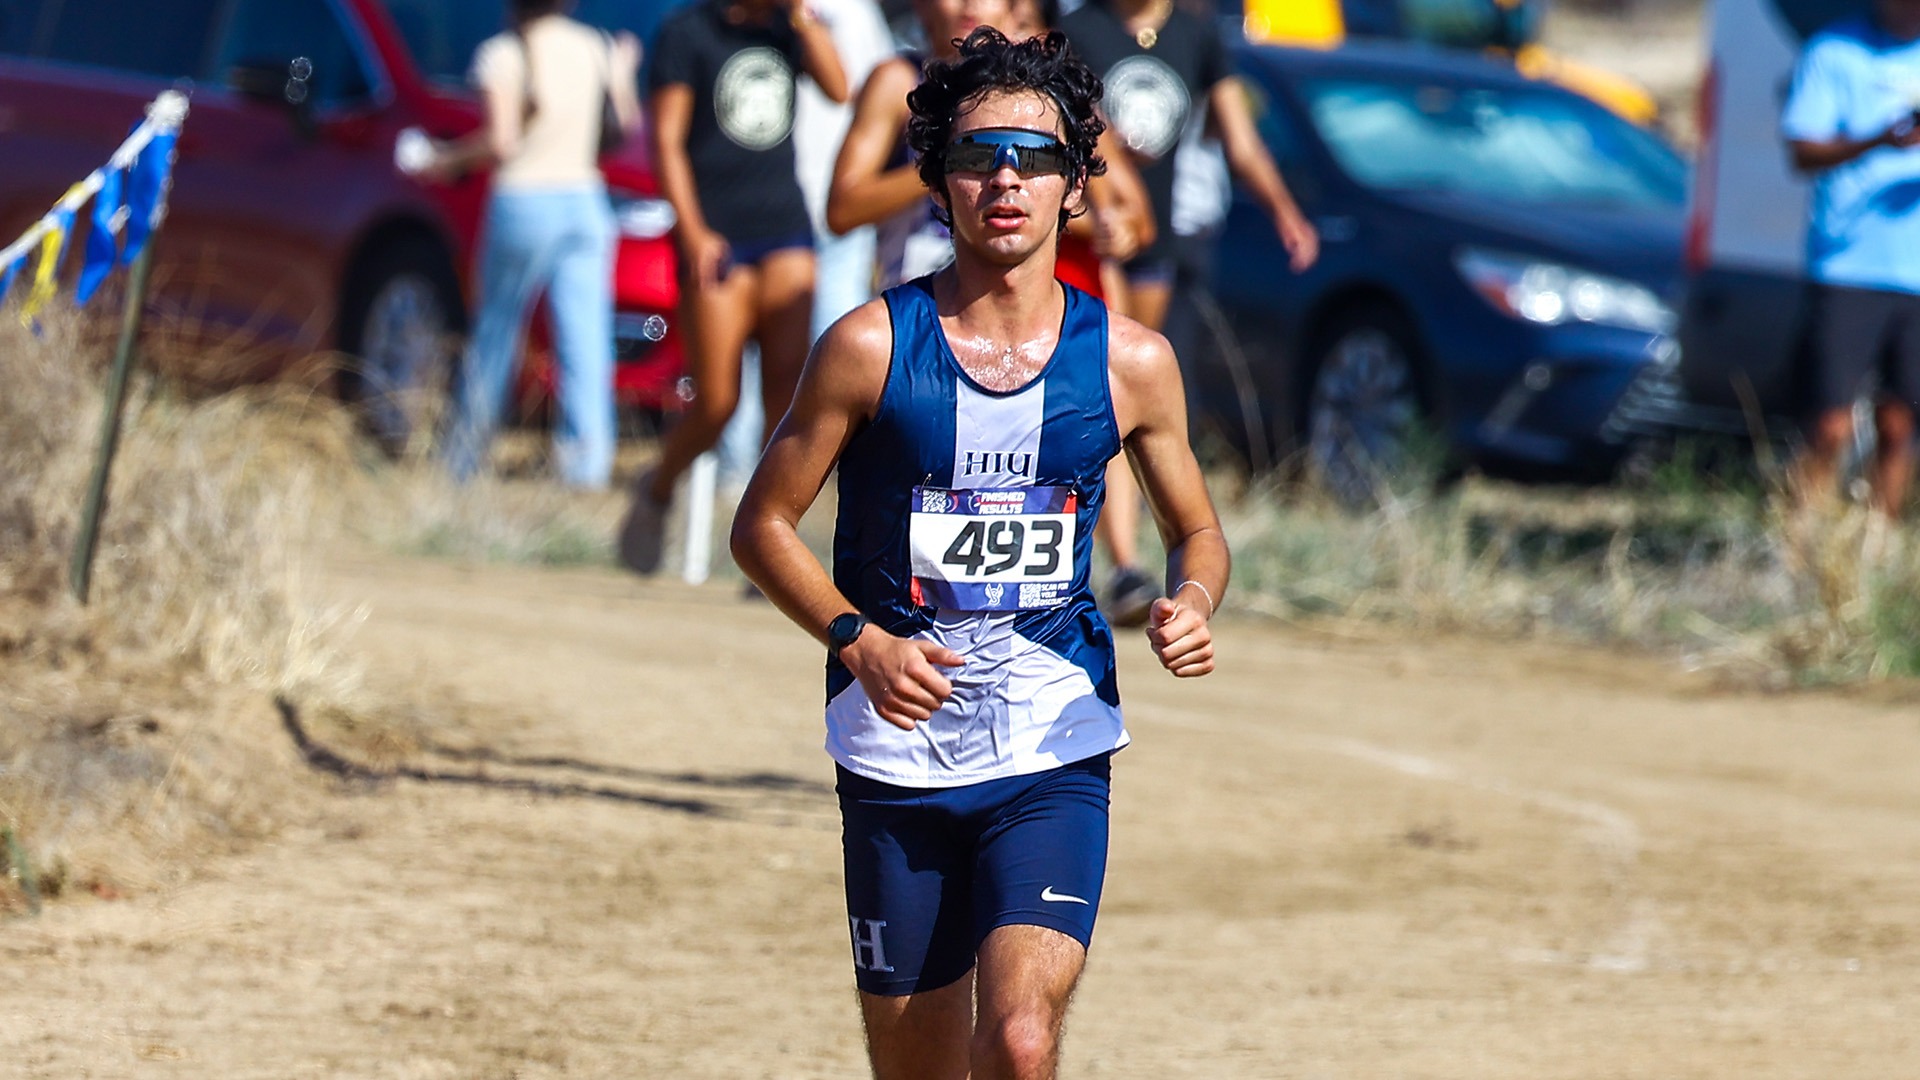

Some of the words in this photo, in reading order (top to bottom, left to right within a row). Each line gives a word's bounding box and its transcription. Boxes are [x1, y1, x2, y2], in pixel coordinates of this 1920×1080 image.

[961, 450, 1034, 479] HIU
[978, 503, 1024, 515] RESULTS
[981, 491, 1026, 502] FINISHED
[942, 520, 1064, 577] 493
[849, 914, 895, 973] H
